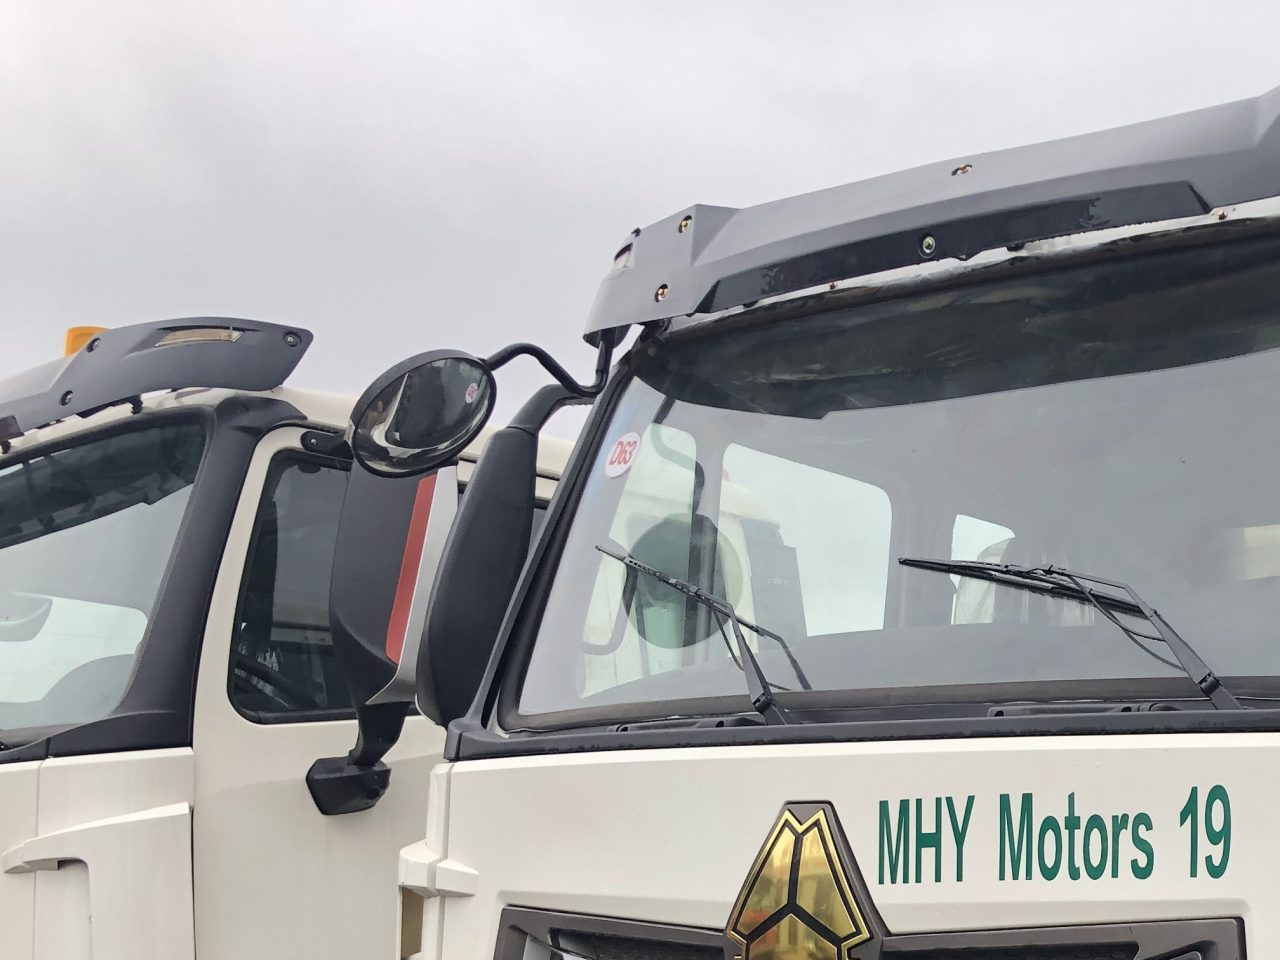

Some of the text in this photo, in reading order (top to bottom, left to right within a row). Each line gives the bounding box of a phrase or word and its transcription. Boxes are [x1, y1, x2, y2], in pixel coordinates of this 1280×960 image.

[609, 440, 638, 465] D63
[878, 783, 1232, 885] MHY Motors 19
